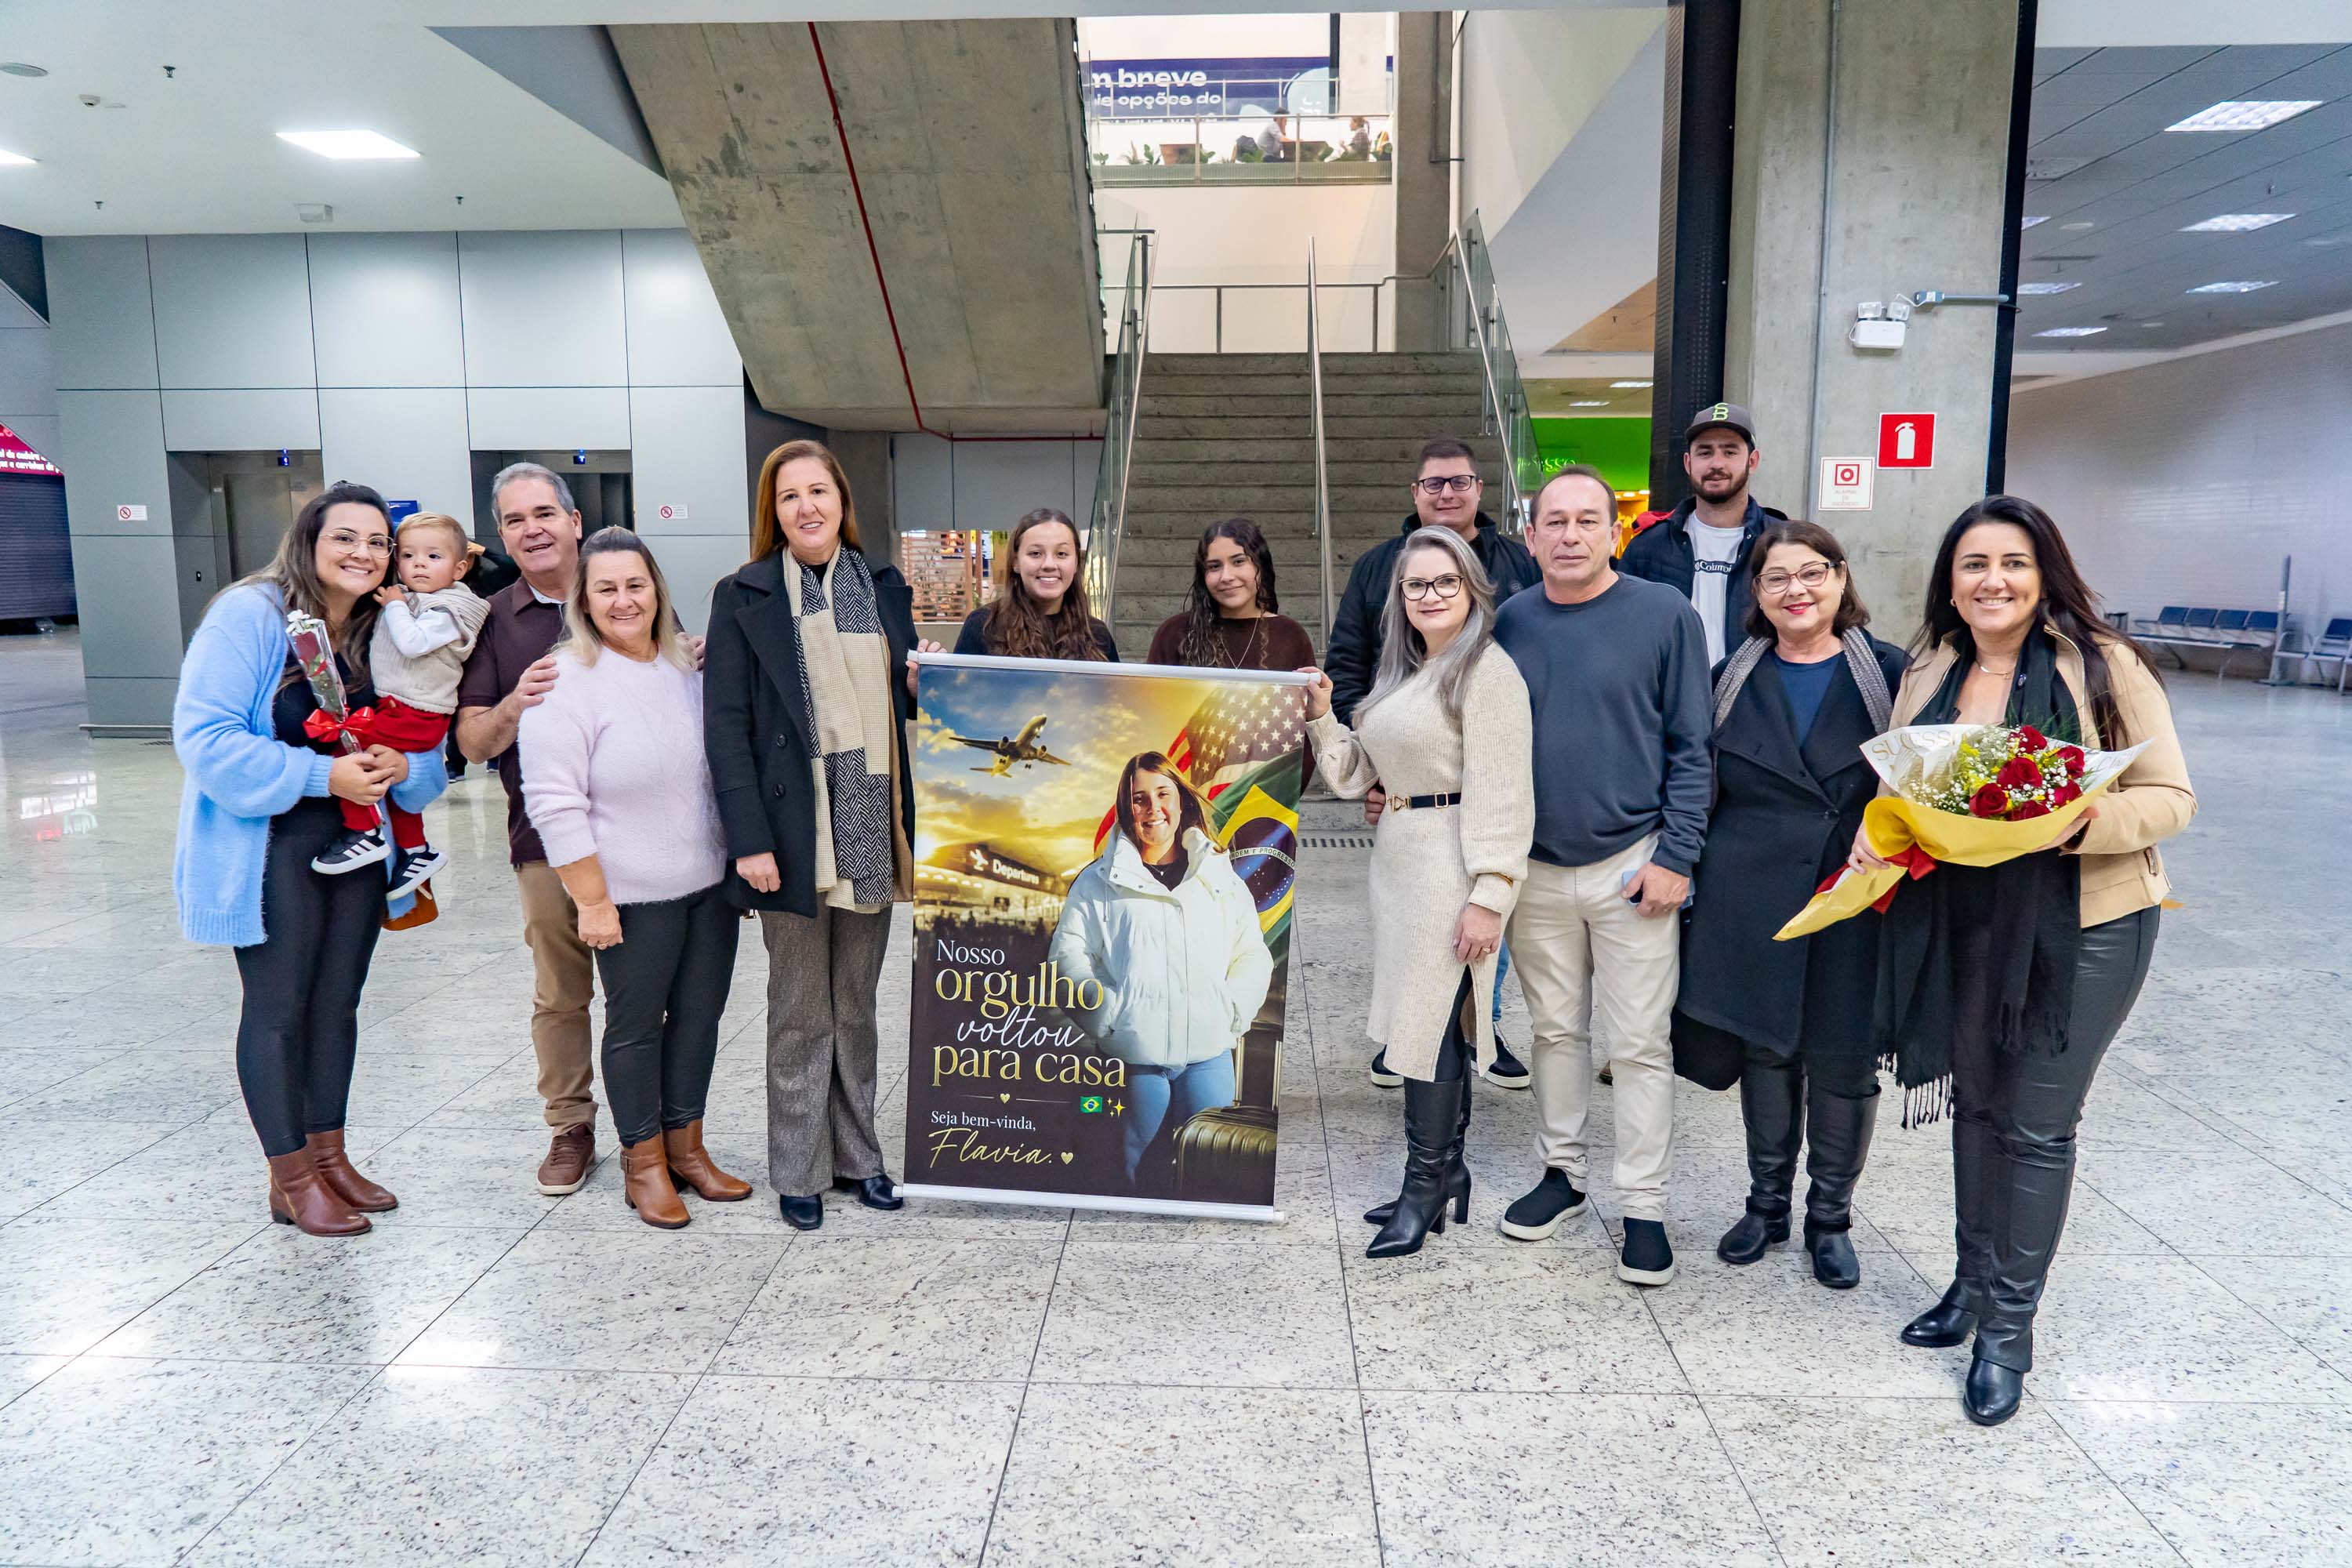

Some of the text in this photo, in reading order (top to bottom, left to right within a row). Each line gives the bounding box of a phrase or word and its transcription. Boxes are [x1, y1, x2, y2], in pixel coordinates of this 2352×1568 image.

[1091, 68, 1207, 89] m breve
[1700, 561, 1732, 573] Columbi
[1229, 849, 1249, 859] RDEM
[1259, 848, 1295, 867] PROGRESSO
[993, 858, 1040, 885] Departures
[936, 939, 1005, 965] Nosso
[935, 960, 1104, 1019] orgulho
[956, 1004, 1084, 1048] voltou
[932, 1045, 1127, 1087] para casa
[931, 1110, 1036, 1131] Seja bem-vinda,
[928, 1127, 1052, 1168] Flavia.
